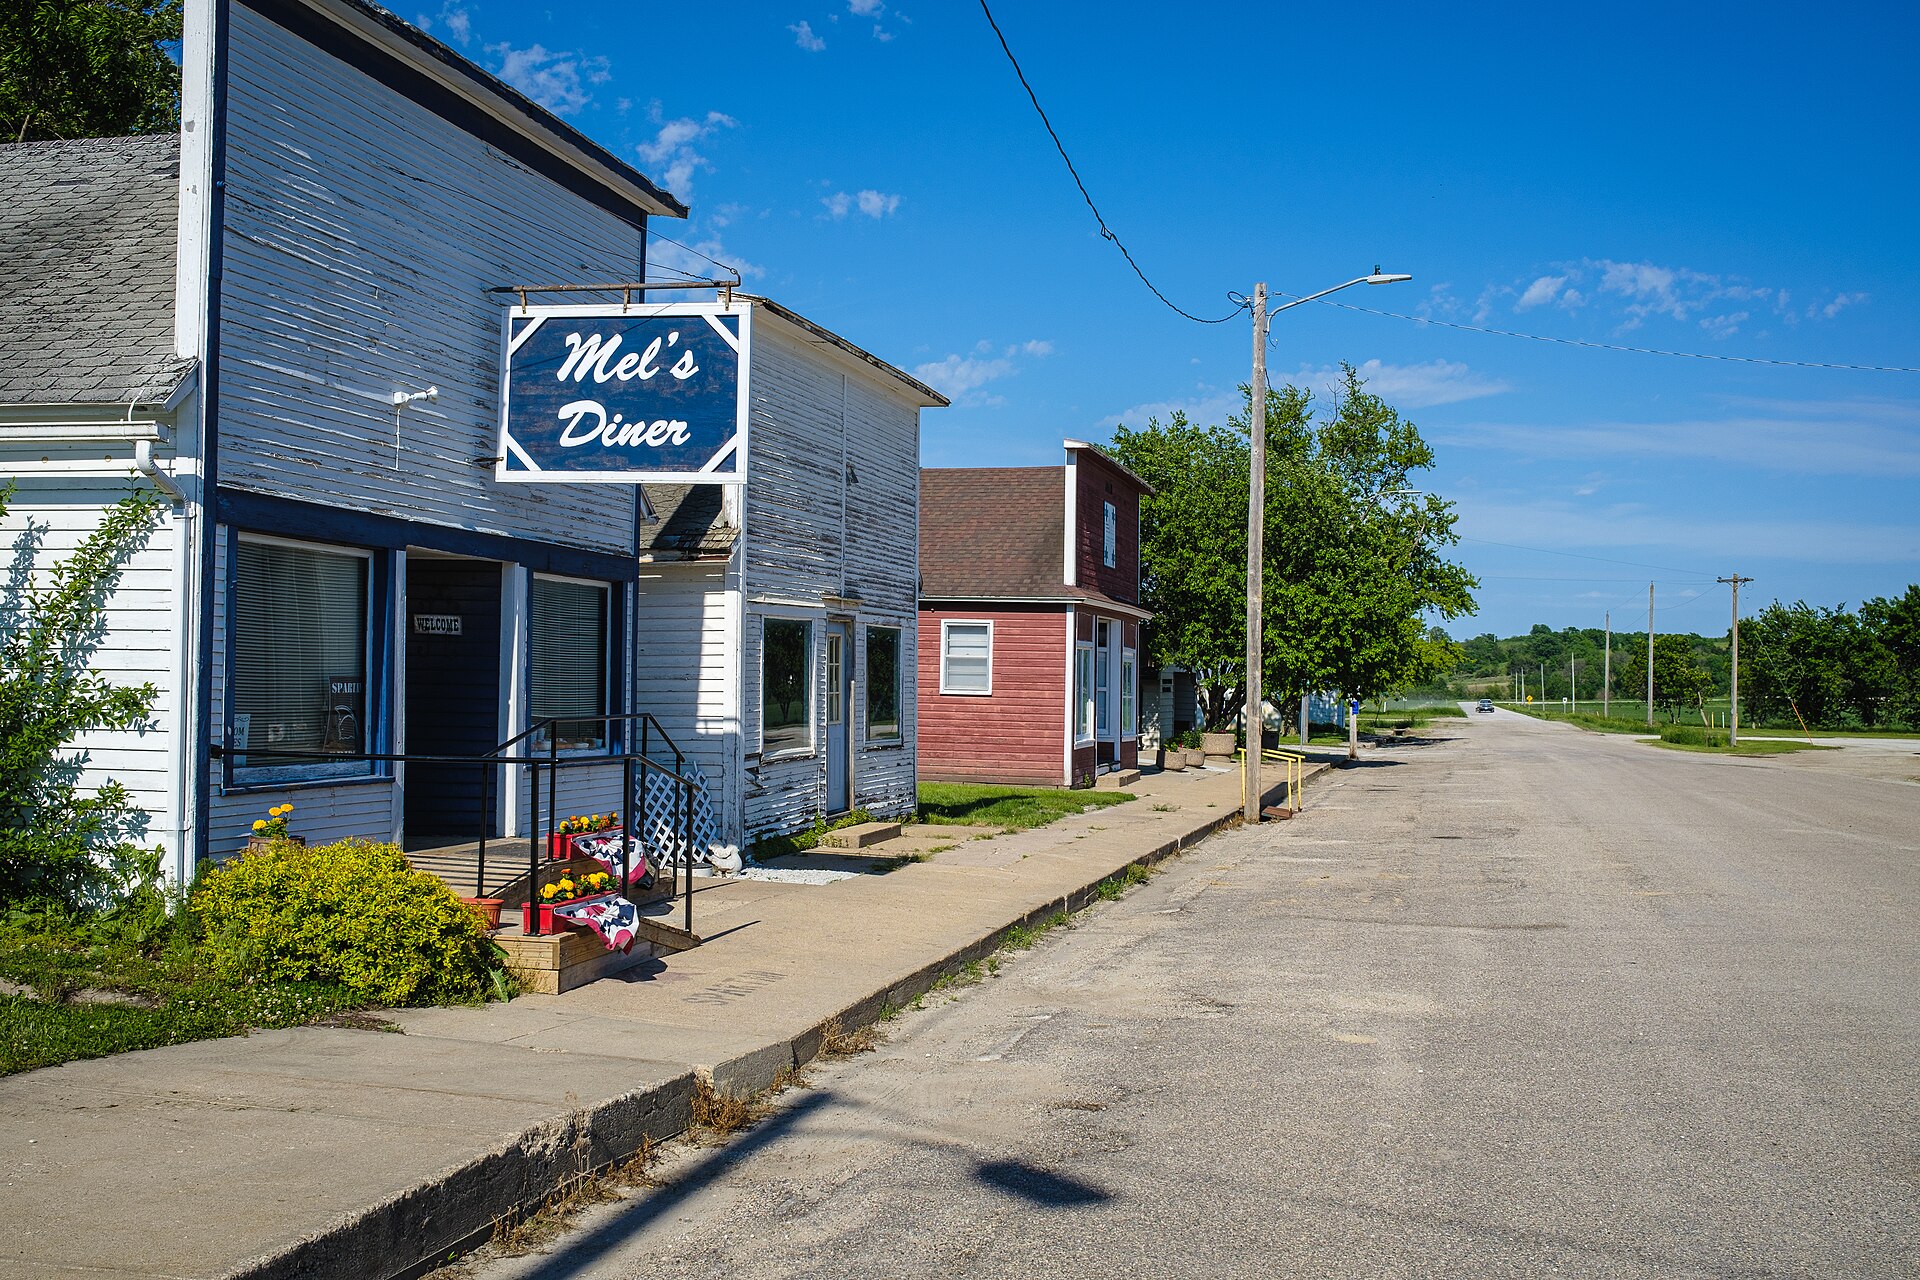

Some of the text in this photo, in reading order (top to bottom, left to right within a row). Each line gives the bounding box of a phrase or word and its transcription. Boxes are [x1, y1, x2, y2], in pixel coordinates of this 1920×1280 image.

[556, 331, 700, 384] Mel's
[557, 399, 692, 448] Diner
[416, 617, 460, 632] WELCOME
